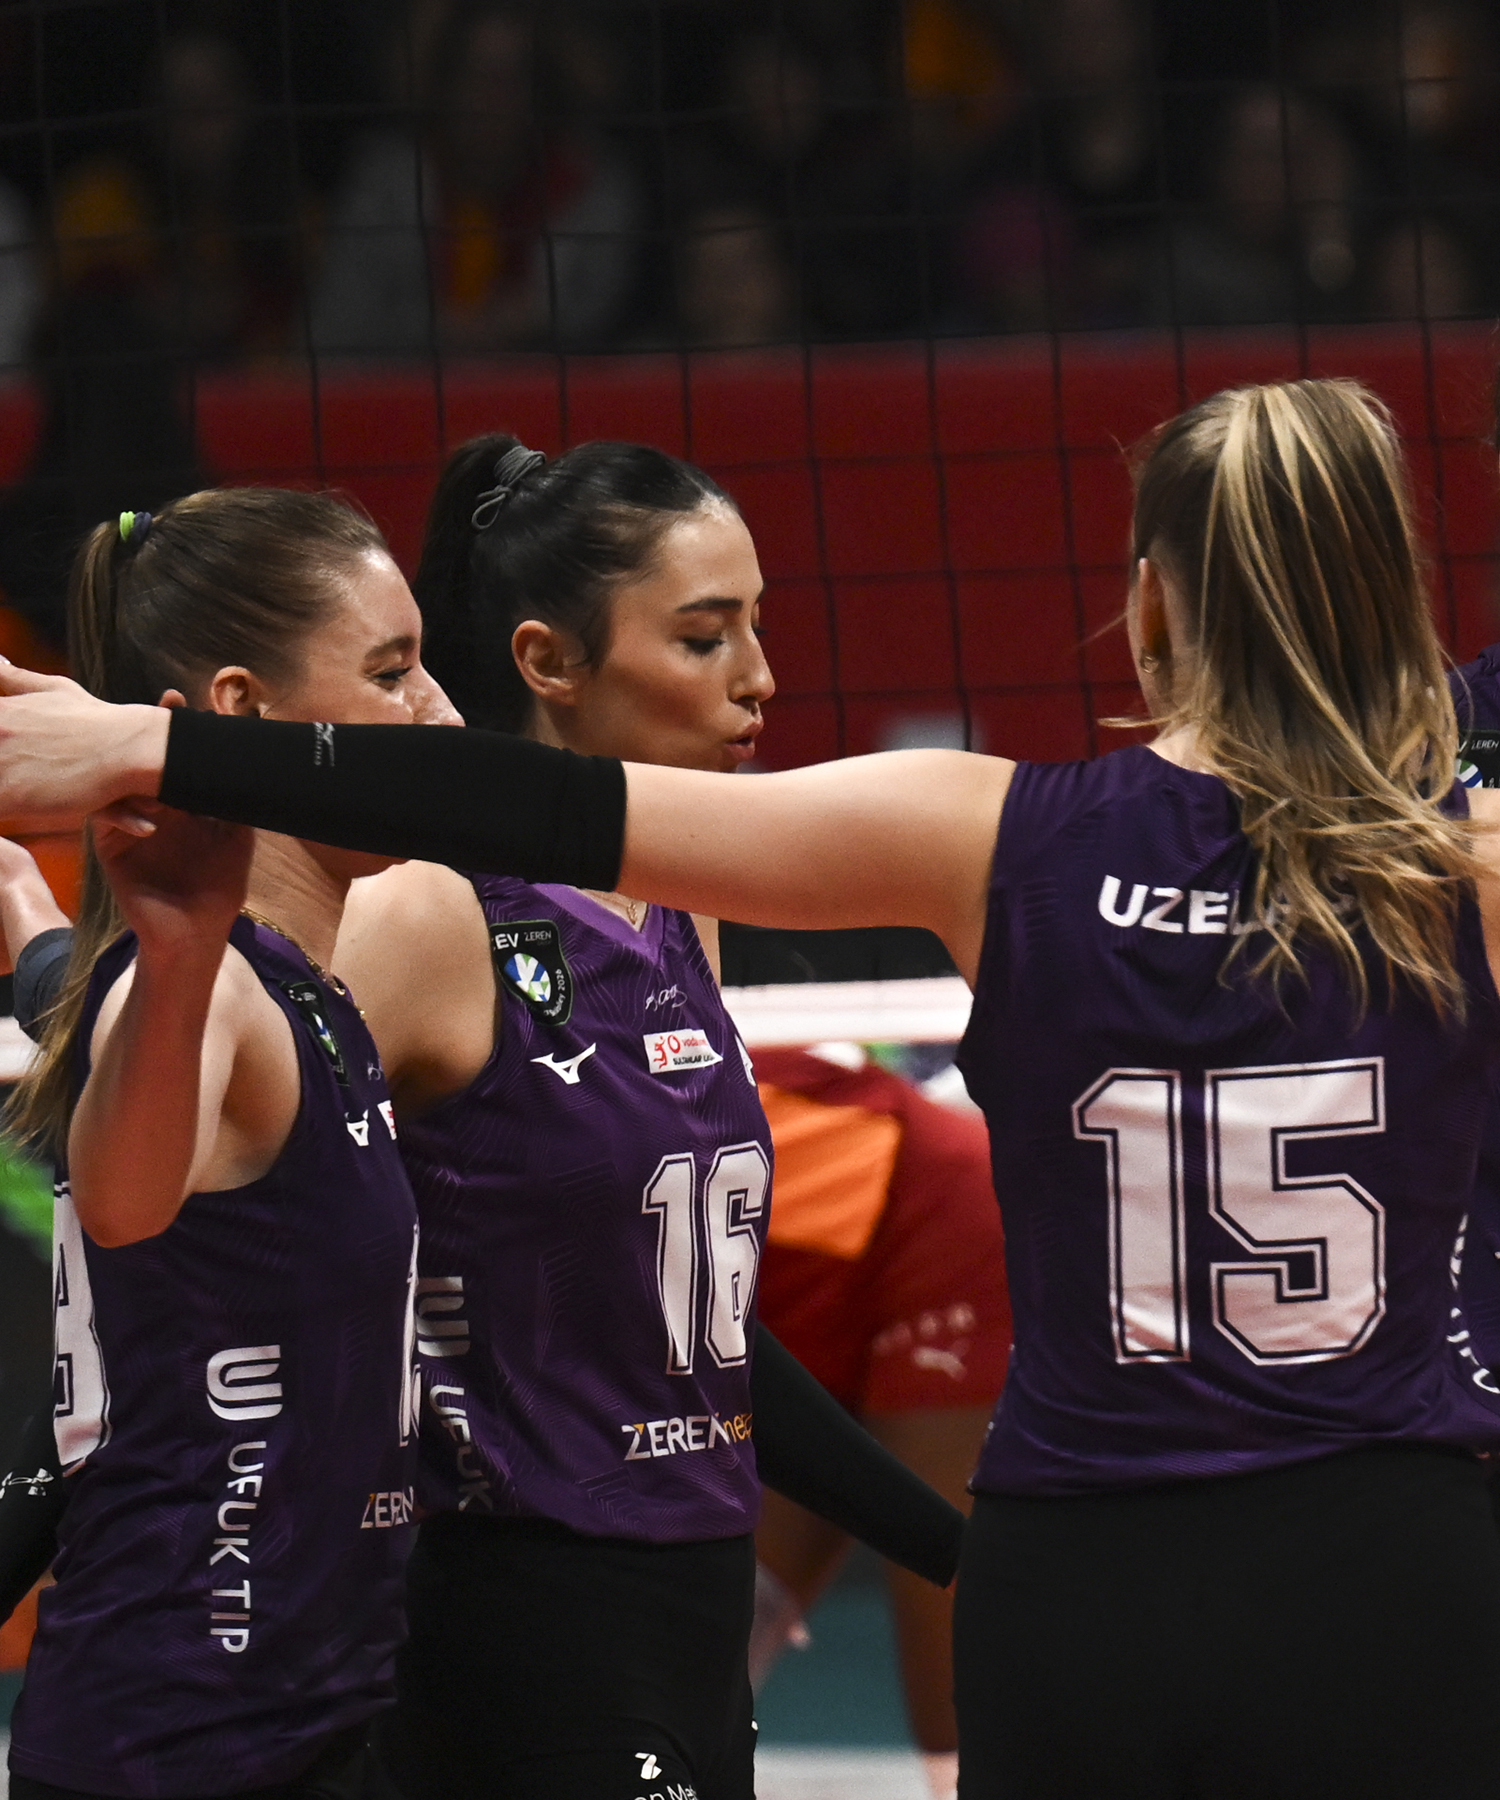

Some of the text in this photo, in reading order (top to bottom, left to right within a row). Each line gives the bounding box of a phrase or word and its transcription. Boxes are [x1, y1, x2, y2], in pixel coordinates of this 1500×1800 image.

[523, 930, 552, 942] ZEREN
[1098, 874, 1280, 937] UZEL
[494, 932, 519, 951] EV
[1072, 1056, 1386, 1366] 15
[641, 1140, 773, 1376] 16
[621, 1413, 730, 1461] ZEREN
[210, 1440, 267, 1653] UFUK TIP
